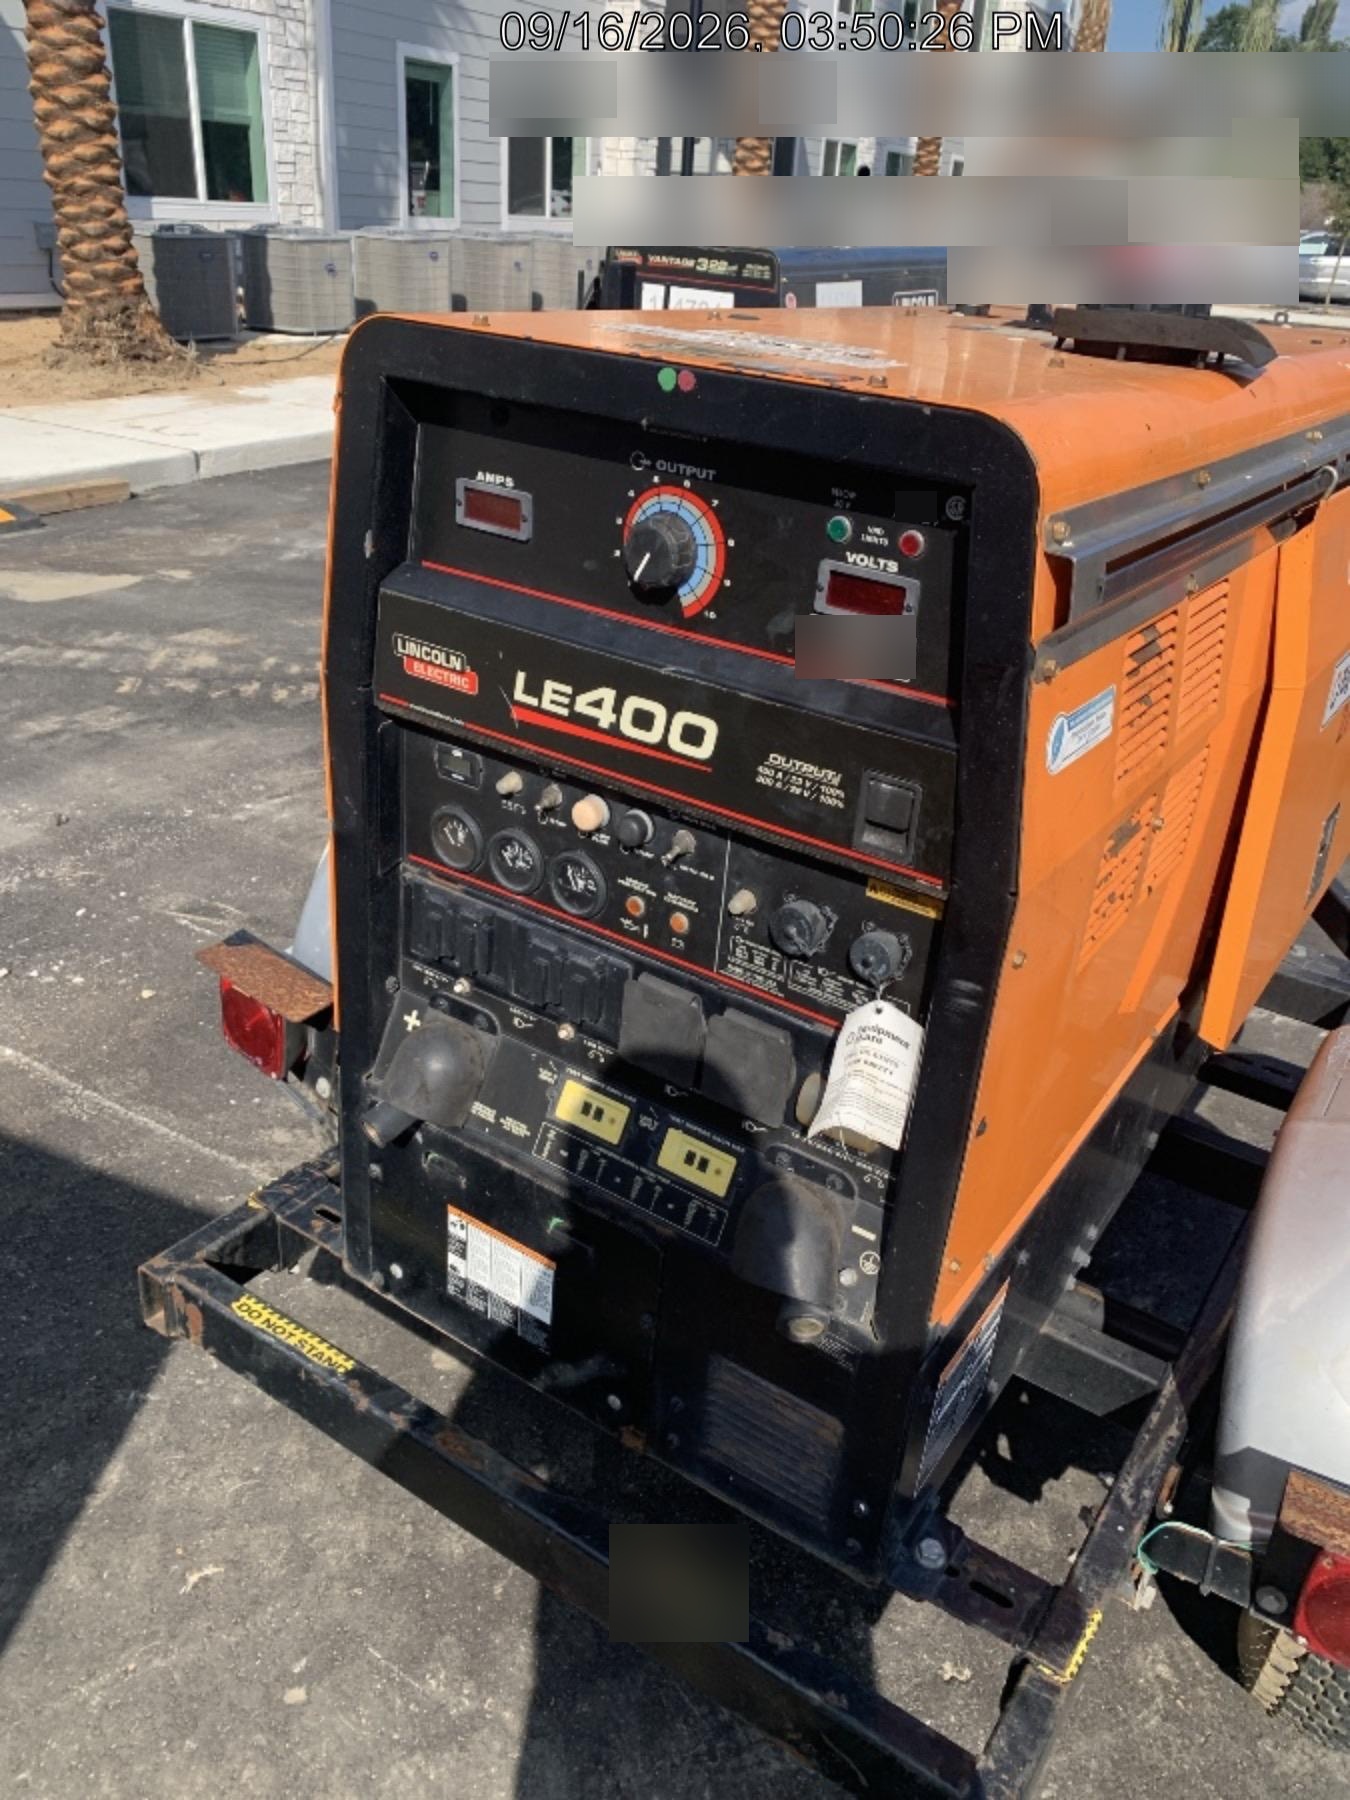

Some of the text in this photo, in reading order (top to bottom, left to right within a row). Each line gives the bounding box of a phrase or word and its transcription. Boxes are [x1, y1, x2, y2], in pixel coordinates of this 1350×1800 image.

[476, 471, 514, 487] AMPS
[656, 459, 716, 480] OUTPUT
[845, 551, 899, 573] VOLTS
[397, 637, 461, 671] LINCOLN
[413, 660, 470, 689] ELECTRIC
[513, 669, 719, 760] LE400
[767, 753, 838, 782] OUTPUT
[237, 1302, 349, 1372] DO NOT STAND
